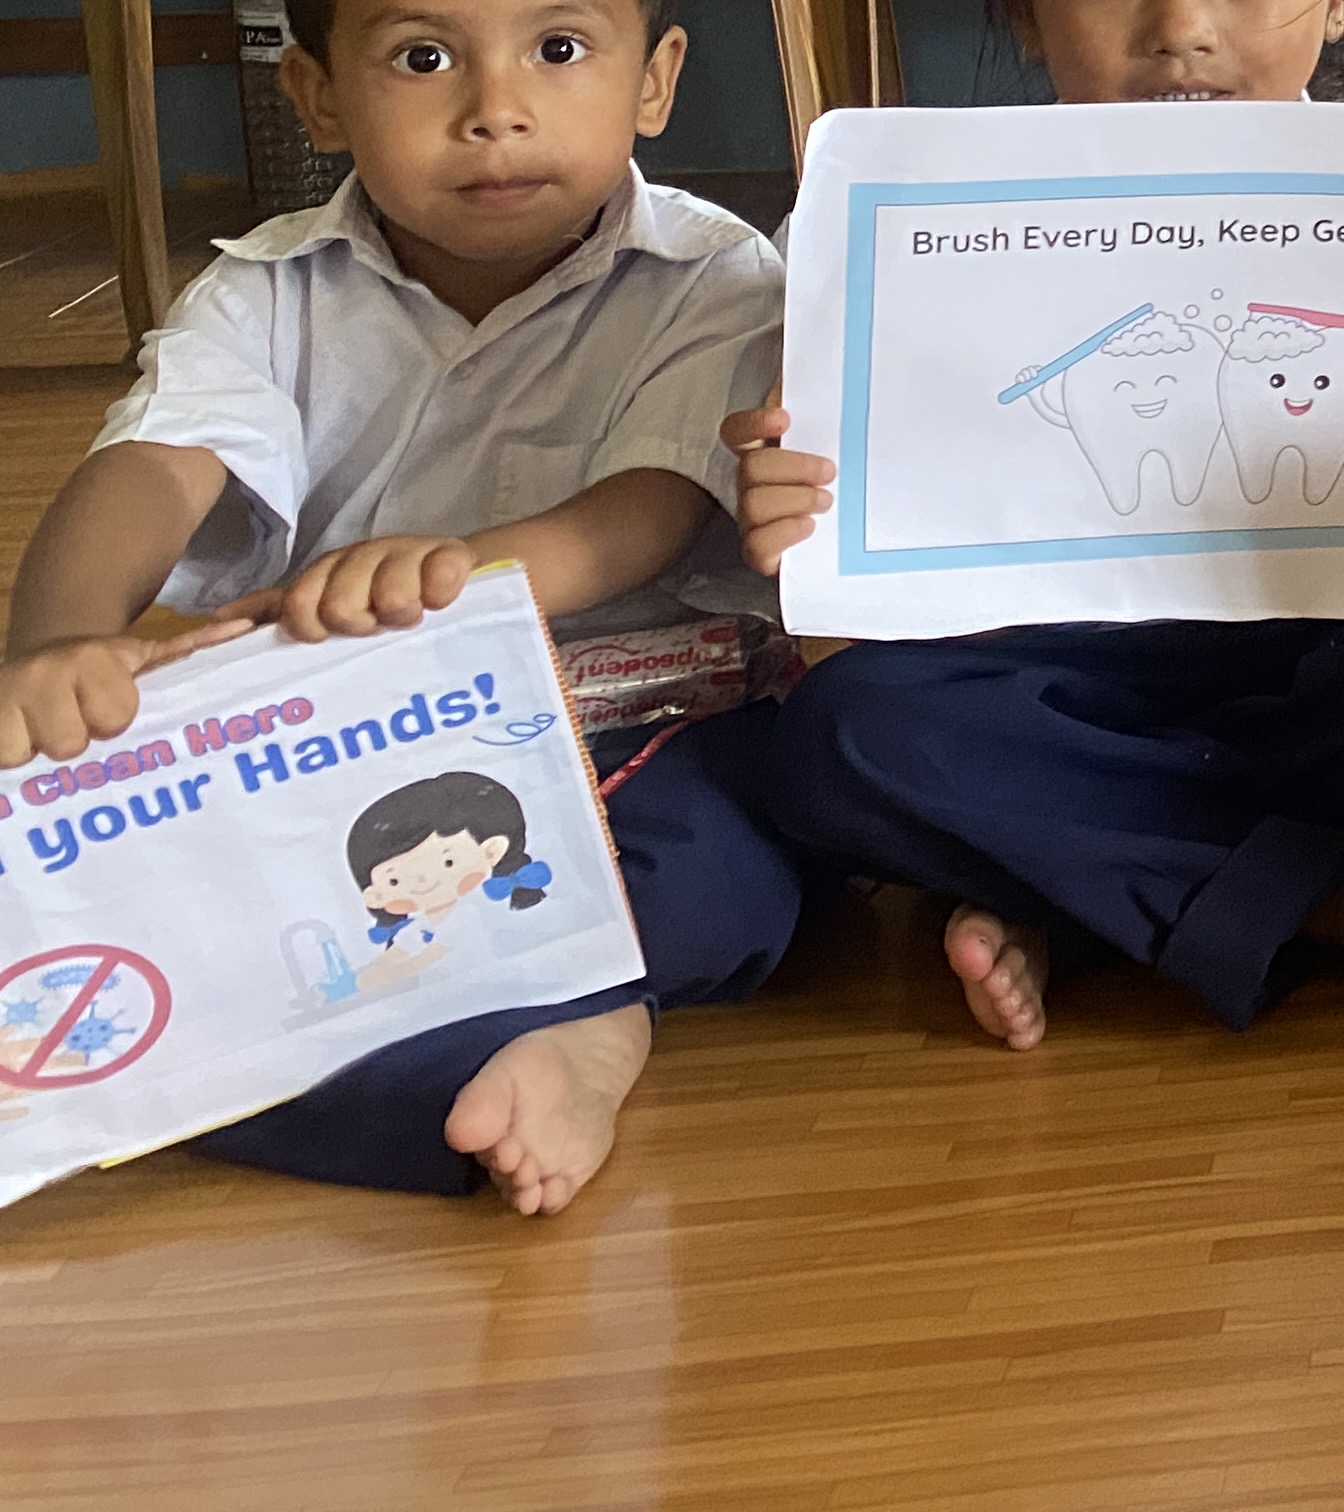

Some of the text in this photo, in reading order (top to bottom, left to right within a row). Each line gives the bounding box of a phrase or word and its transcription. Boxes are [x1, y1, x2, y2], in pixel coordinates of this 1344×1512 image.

[912, 227, 1010, 255] Brush
[1023, 225, 1117, 253] Every
[1130, 221, 1205, 250] Day,
[1218, 219, 1301, 248] Keep
[20, 697, 314, 806] Clean Hero
[27, 672, 501, 874] your Hands!
